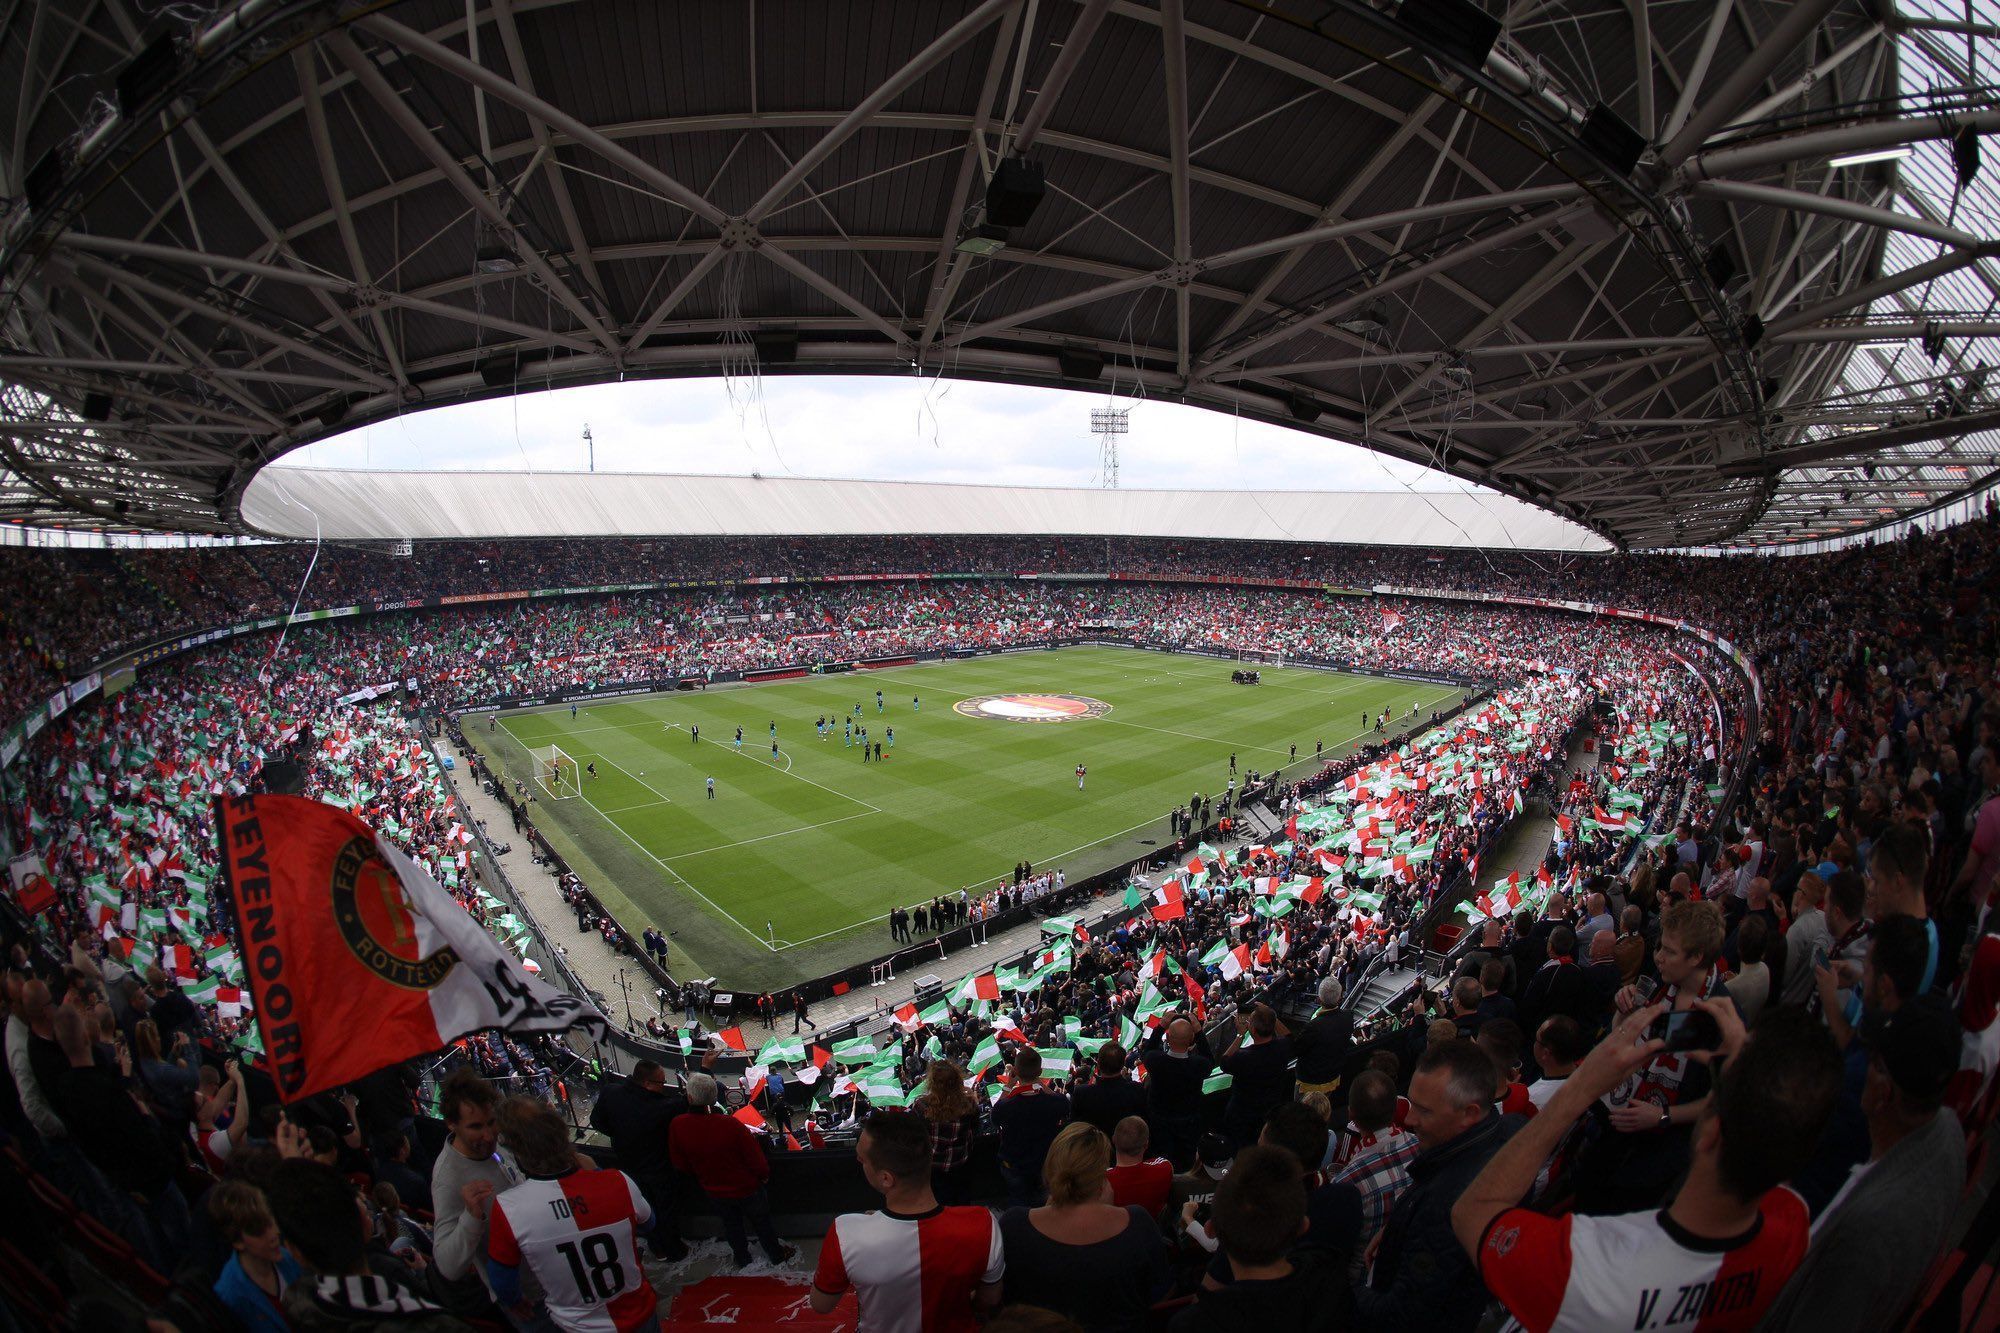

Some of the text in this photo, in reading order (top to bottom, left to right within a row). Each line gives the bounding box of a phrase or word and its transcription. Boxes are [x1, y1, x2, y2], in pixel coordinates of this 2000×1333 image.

[384, 601, 406, 611] pepsi
[230, 794, 308, 1094] FEYENOORD
[355, 938, 451, 984] ROTTERD
[555, 1232, 626, 1304] 18
[1633, 1266, 1762, 1331] V. ZANTEN
